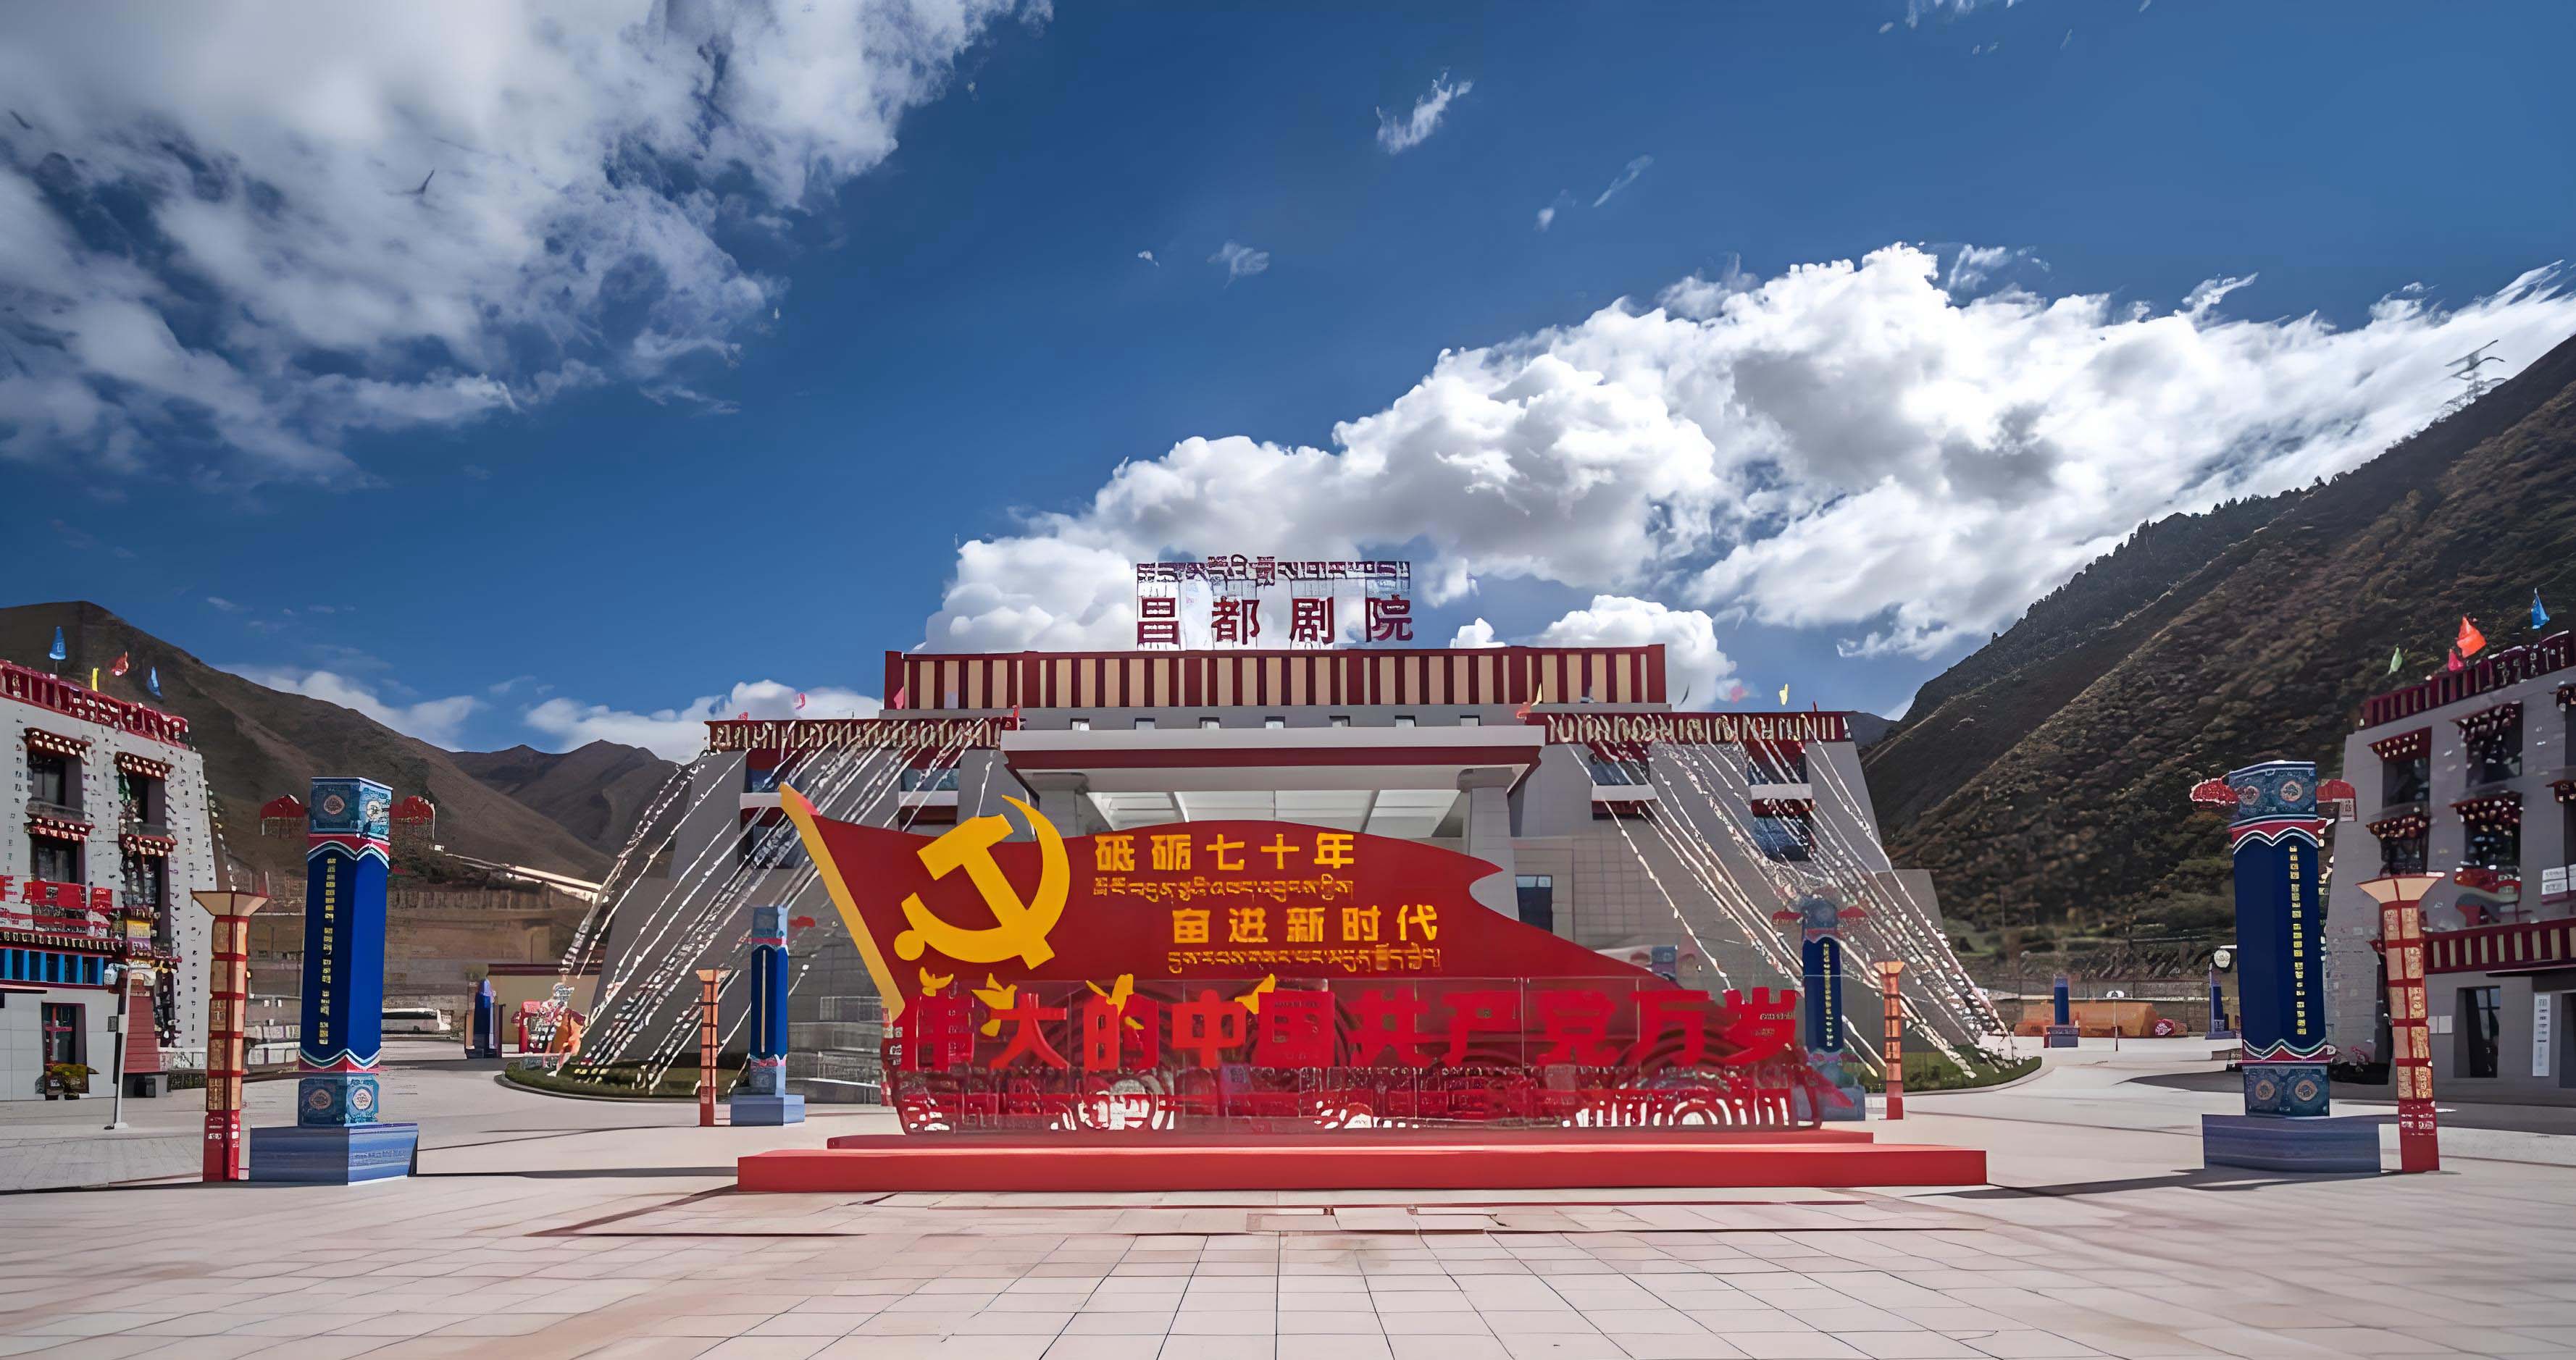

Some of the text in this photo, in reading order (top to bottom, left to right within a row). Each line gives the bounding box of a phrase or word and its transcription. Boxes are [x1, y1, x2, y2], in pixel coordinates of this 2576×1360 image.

[1137, 595, 1413, 645] 昌都剧院
[1095, 833, 1355, 871] 砥砺七十年
[1172, 904, 1438, 943] 奋进新时代
